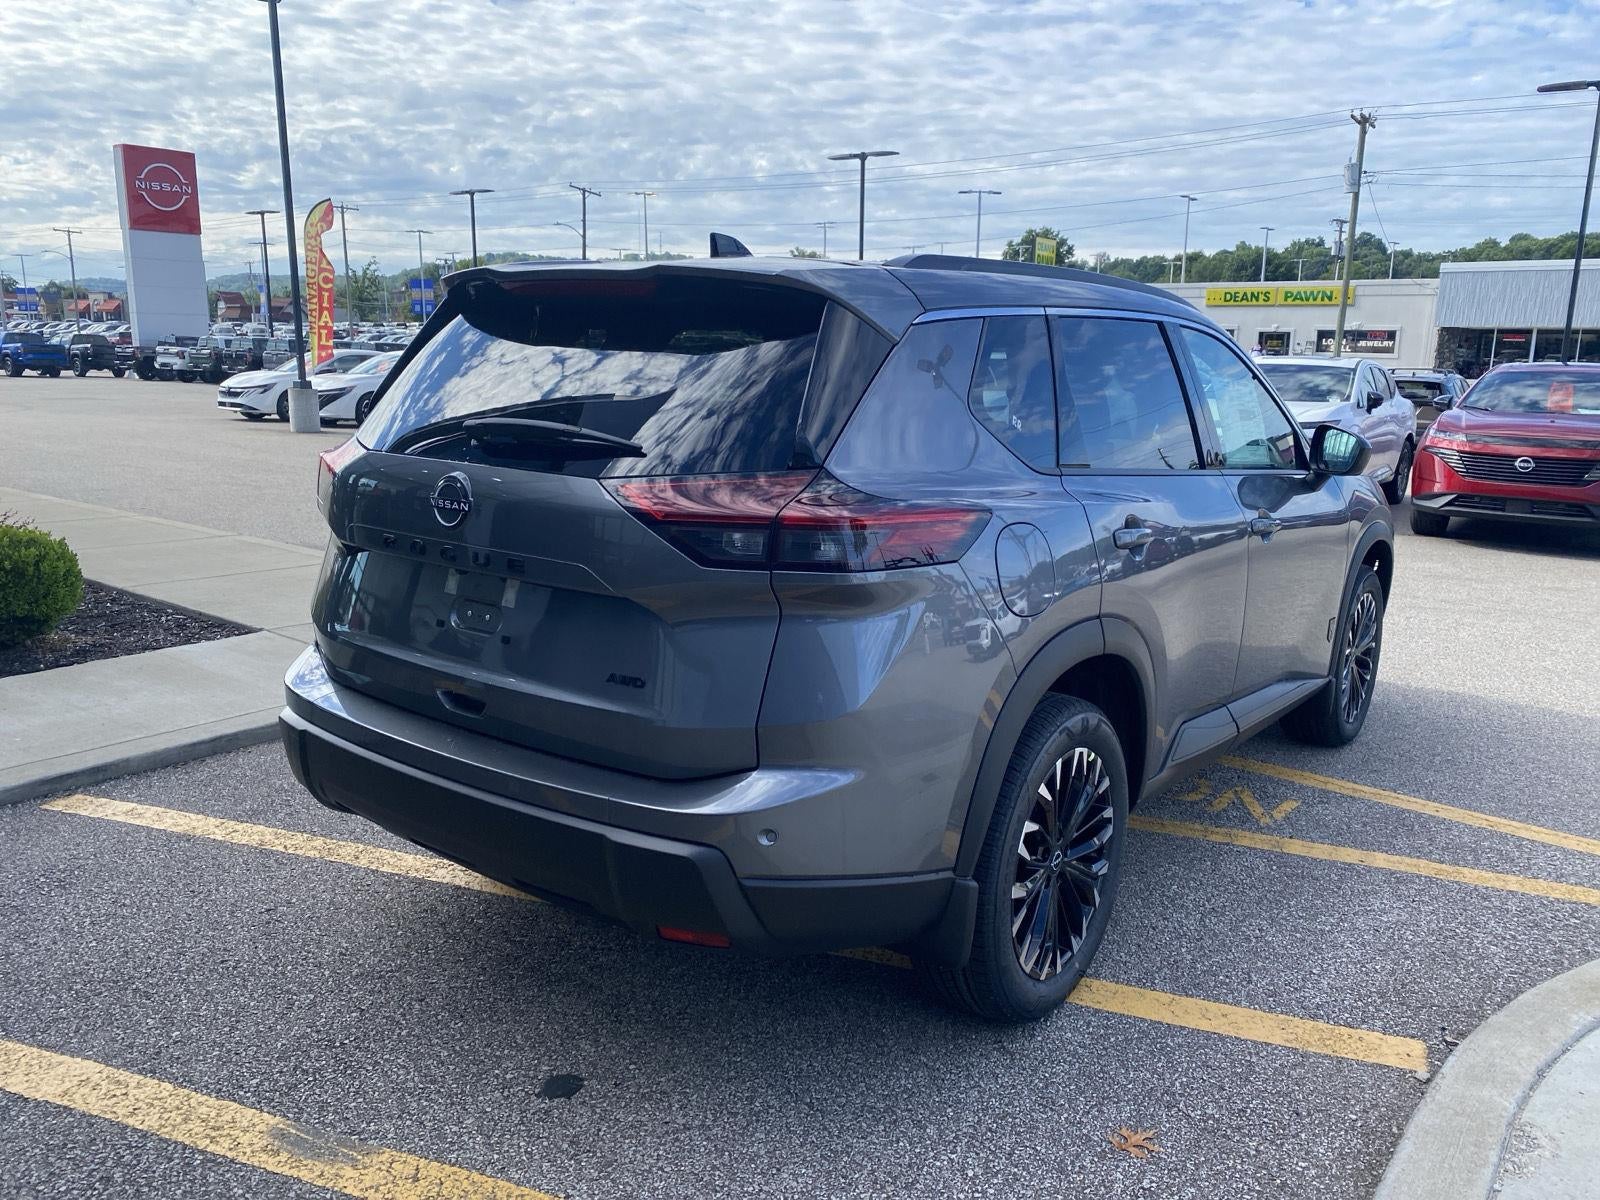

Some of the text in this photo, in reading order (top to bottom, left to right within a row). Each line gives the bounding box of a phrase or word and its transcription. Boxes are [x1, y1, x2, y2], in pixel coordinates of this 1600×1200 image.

[135, 180, 192, 194] NISSAN
[1223, 290, 1334, 303] DEAN'S PAWN
[1322, 338, 1347, 346] LON
[1330, 344, 1352, 352] SLL
[1356, 340, 1394, 348] JEWELRY
[430, 497, 470, 512] NISSAN
[383, 533, 526, 574] ROGUE
[605, 672, 647, 689] AWD
